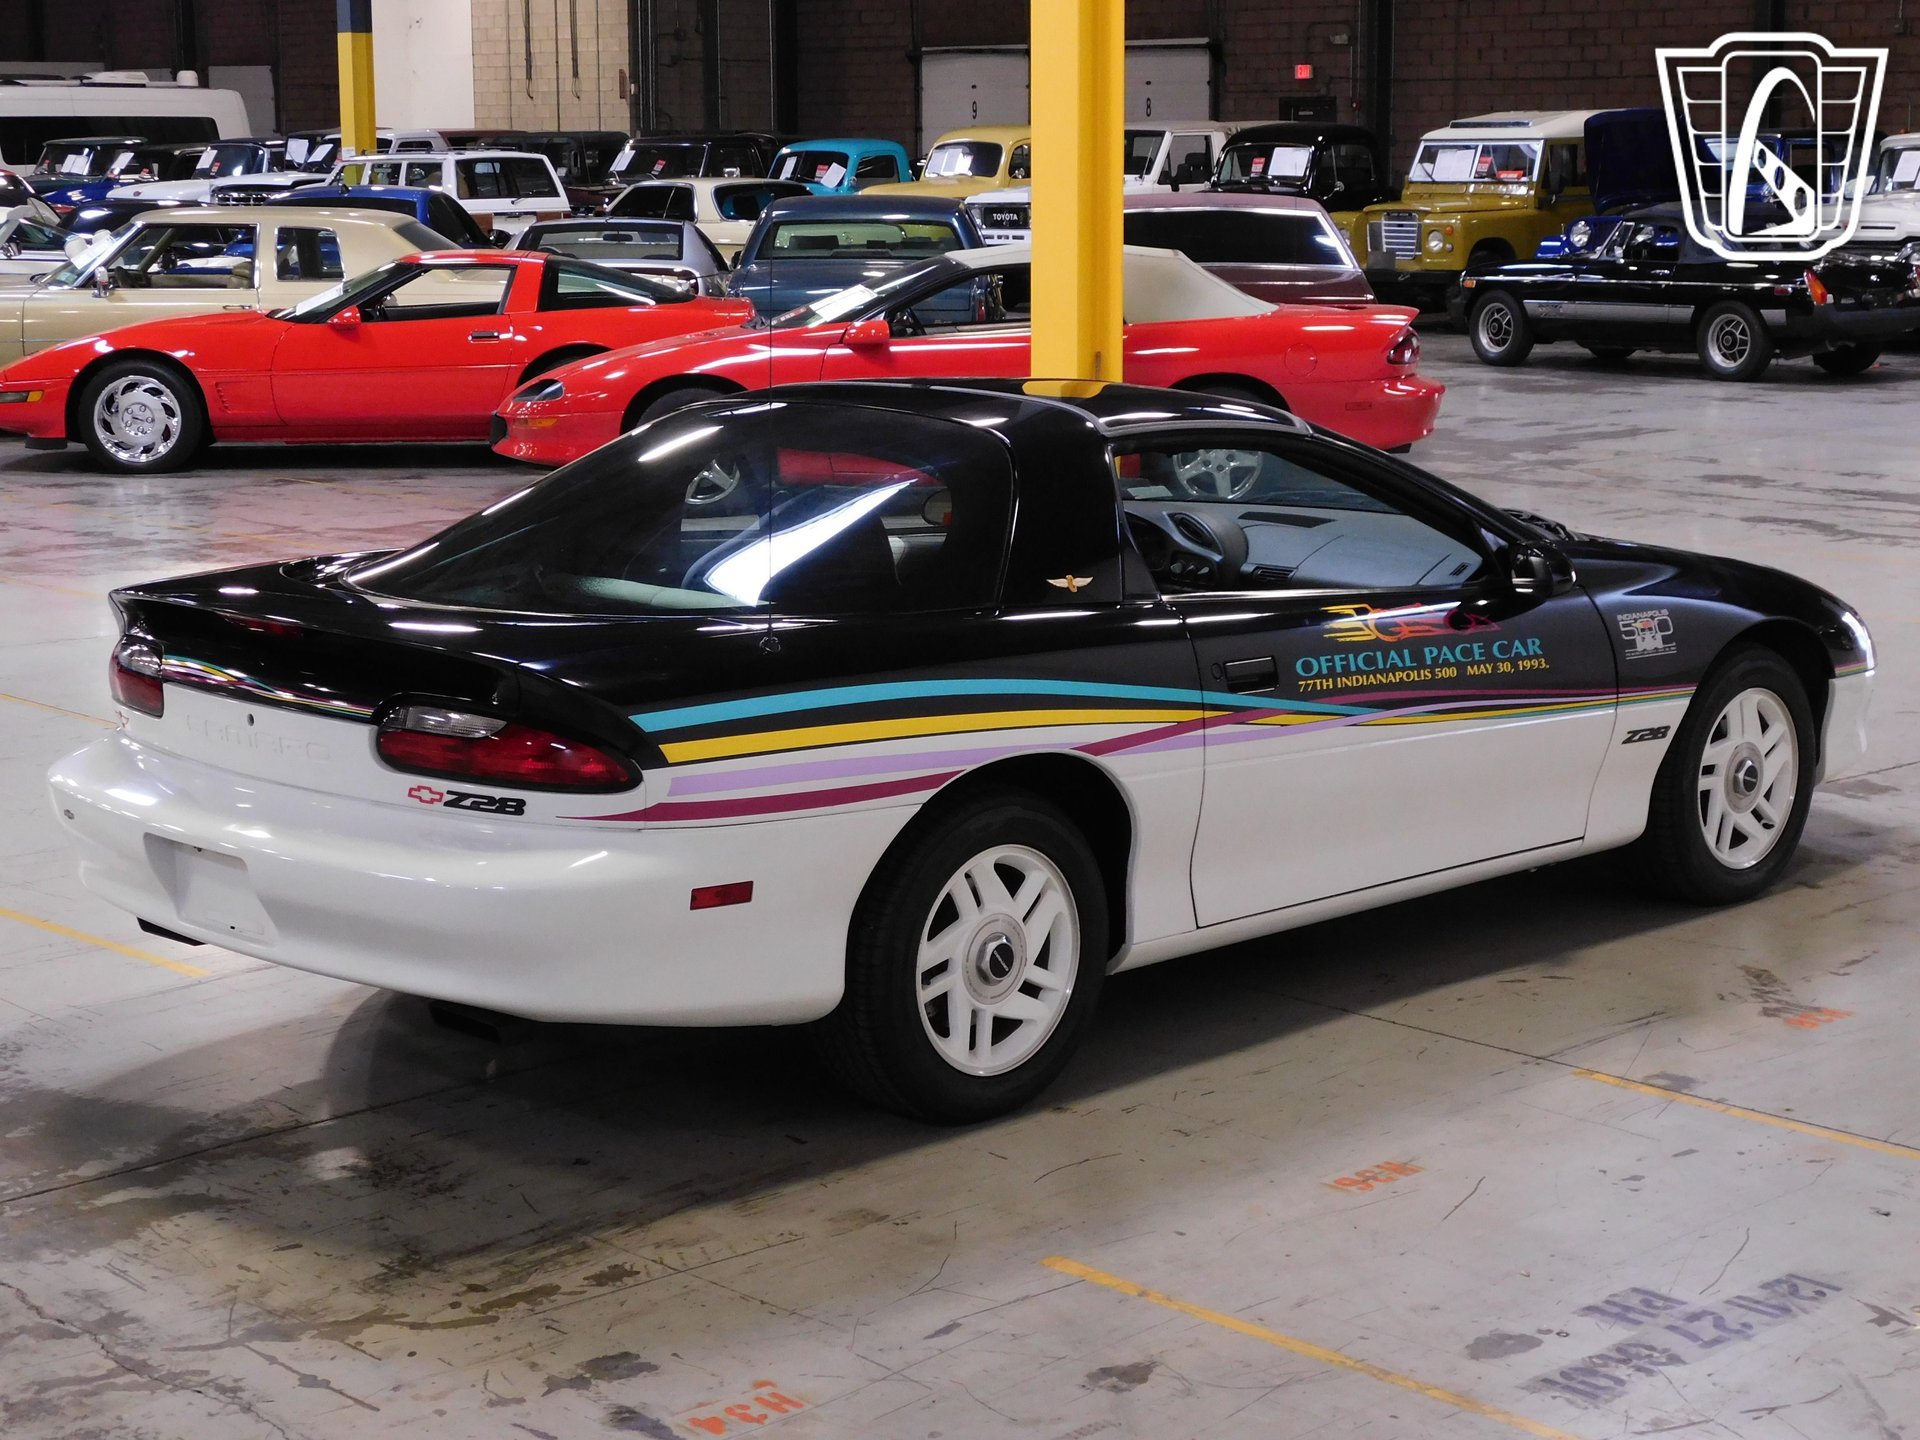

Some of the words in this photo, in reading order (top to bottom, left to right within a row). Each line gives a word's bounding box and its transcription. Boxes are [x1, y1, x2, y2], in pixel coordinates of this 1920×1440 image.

[971, 101, 978, 119] 9
[1145, 97, 1152, 117] 8
[992, 213, 1019, 221] TOYOTA
[1617, 609, 1669, 621] INDIANAPOLIS
[1619, 616, 1673, 640] 500
[1295, 648, 1417, 677] OFFICIAL
[1424, 642, 1486, 665] PACE
[1492, 637, 1543, 659] CAR
[1298, 676, 1334, 693] 77TH
[1337, 668, 1432, 688] INDIANAPOLIS
[1434, 666, 1457, 679] 500
[1466, 663, 1494, 676] MAY
[1496, 661, 1515, 674] 30,
[1518, 657, 1550, 671] 1993.
[1621, 725, 1672, 744] Z28
[443, 790, 527, 816] Z28
